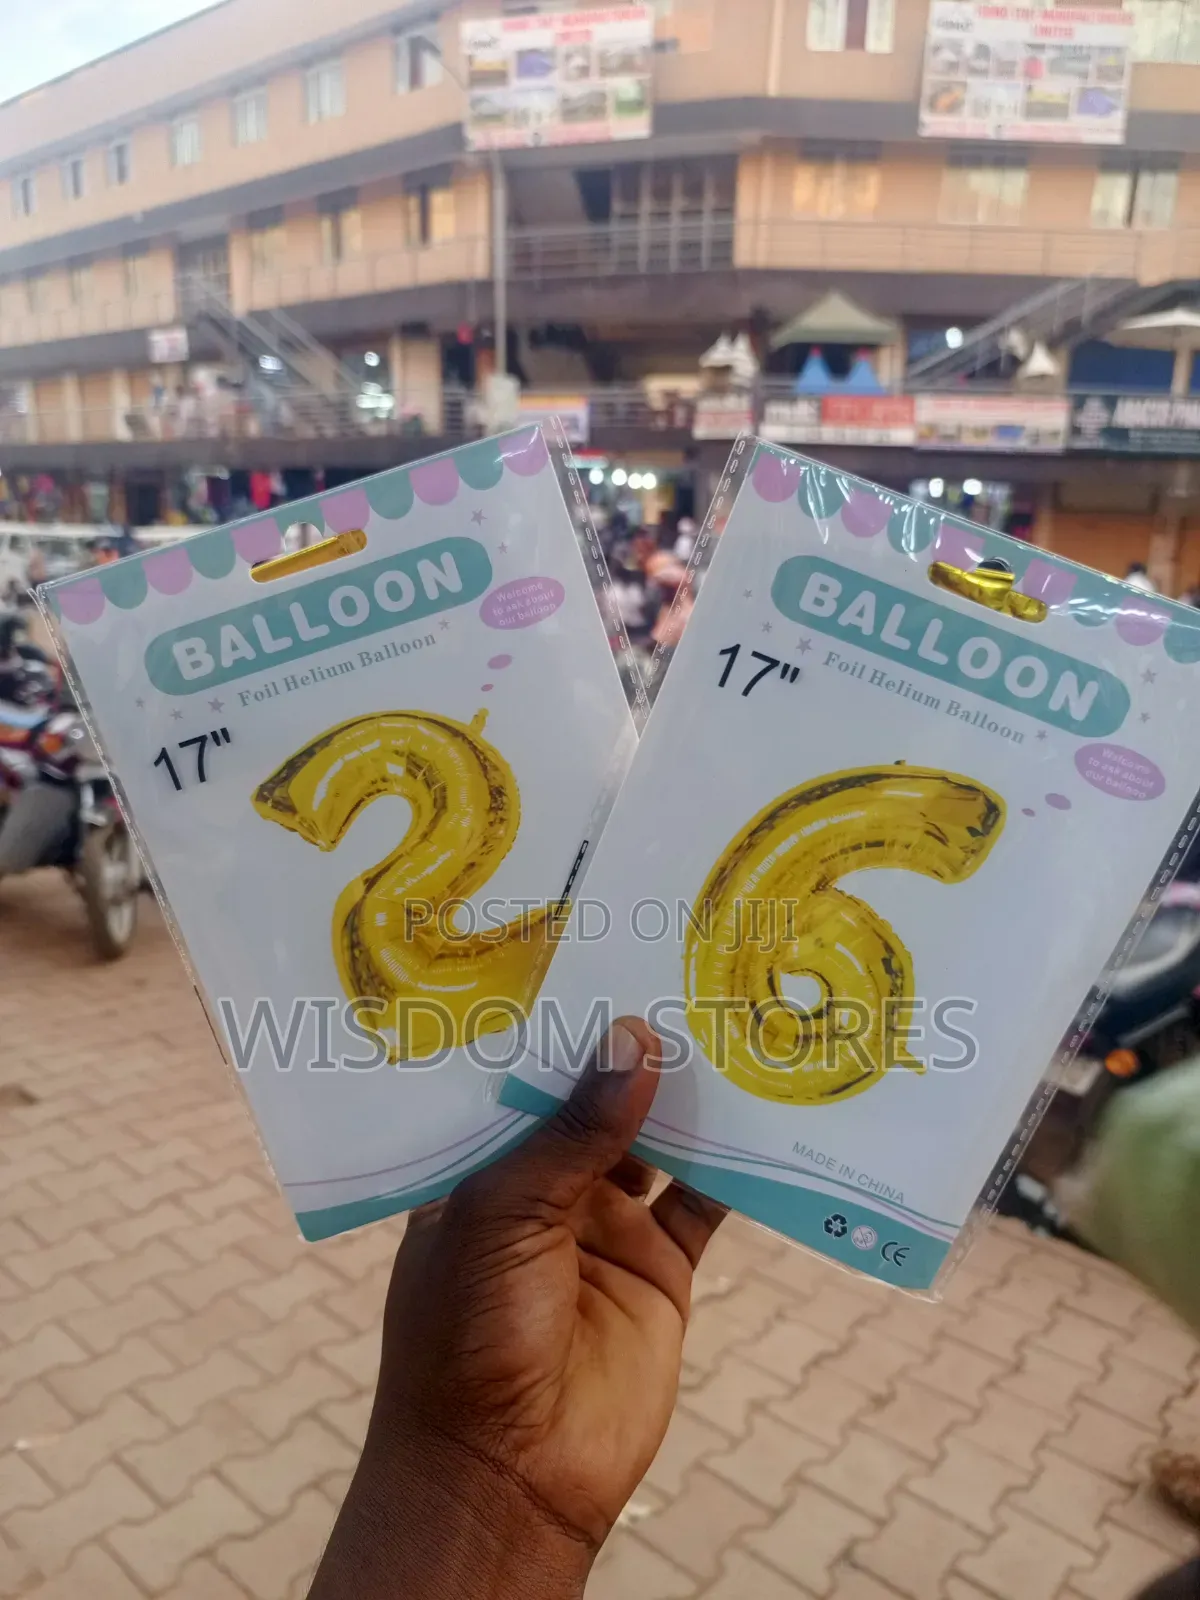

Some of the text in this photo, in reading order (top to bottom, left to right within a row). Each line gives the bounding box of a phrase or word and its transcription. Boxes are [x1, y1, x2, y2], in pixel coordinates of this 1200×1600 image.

[171, 551, 463, 681] BALLOON
[492, 588, 555, 617] to ask about
[496, 582, 543, 603] Welcome
[499, 602, 556, 626] our balloon
[237, 631, 437, 708] Foil Helium Balloon
[716, 642, 801, 698] 17"
[798, 571, 1100, 722] BALLOON
[821, 650, 1026, 745] Foil Helium Balloon
[152, 726, 232, 792] 17"
[792, 1141, 906, 1204] MADE IN CHINA
